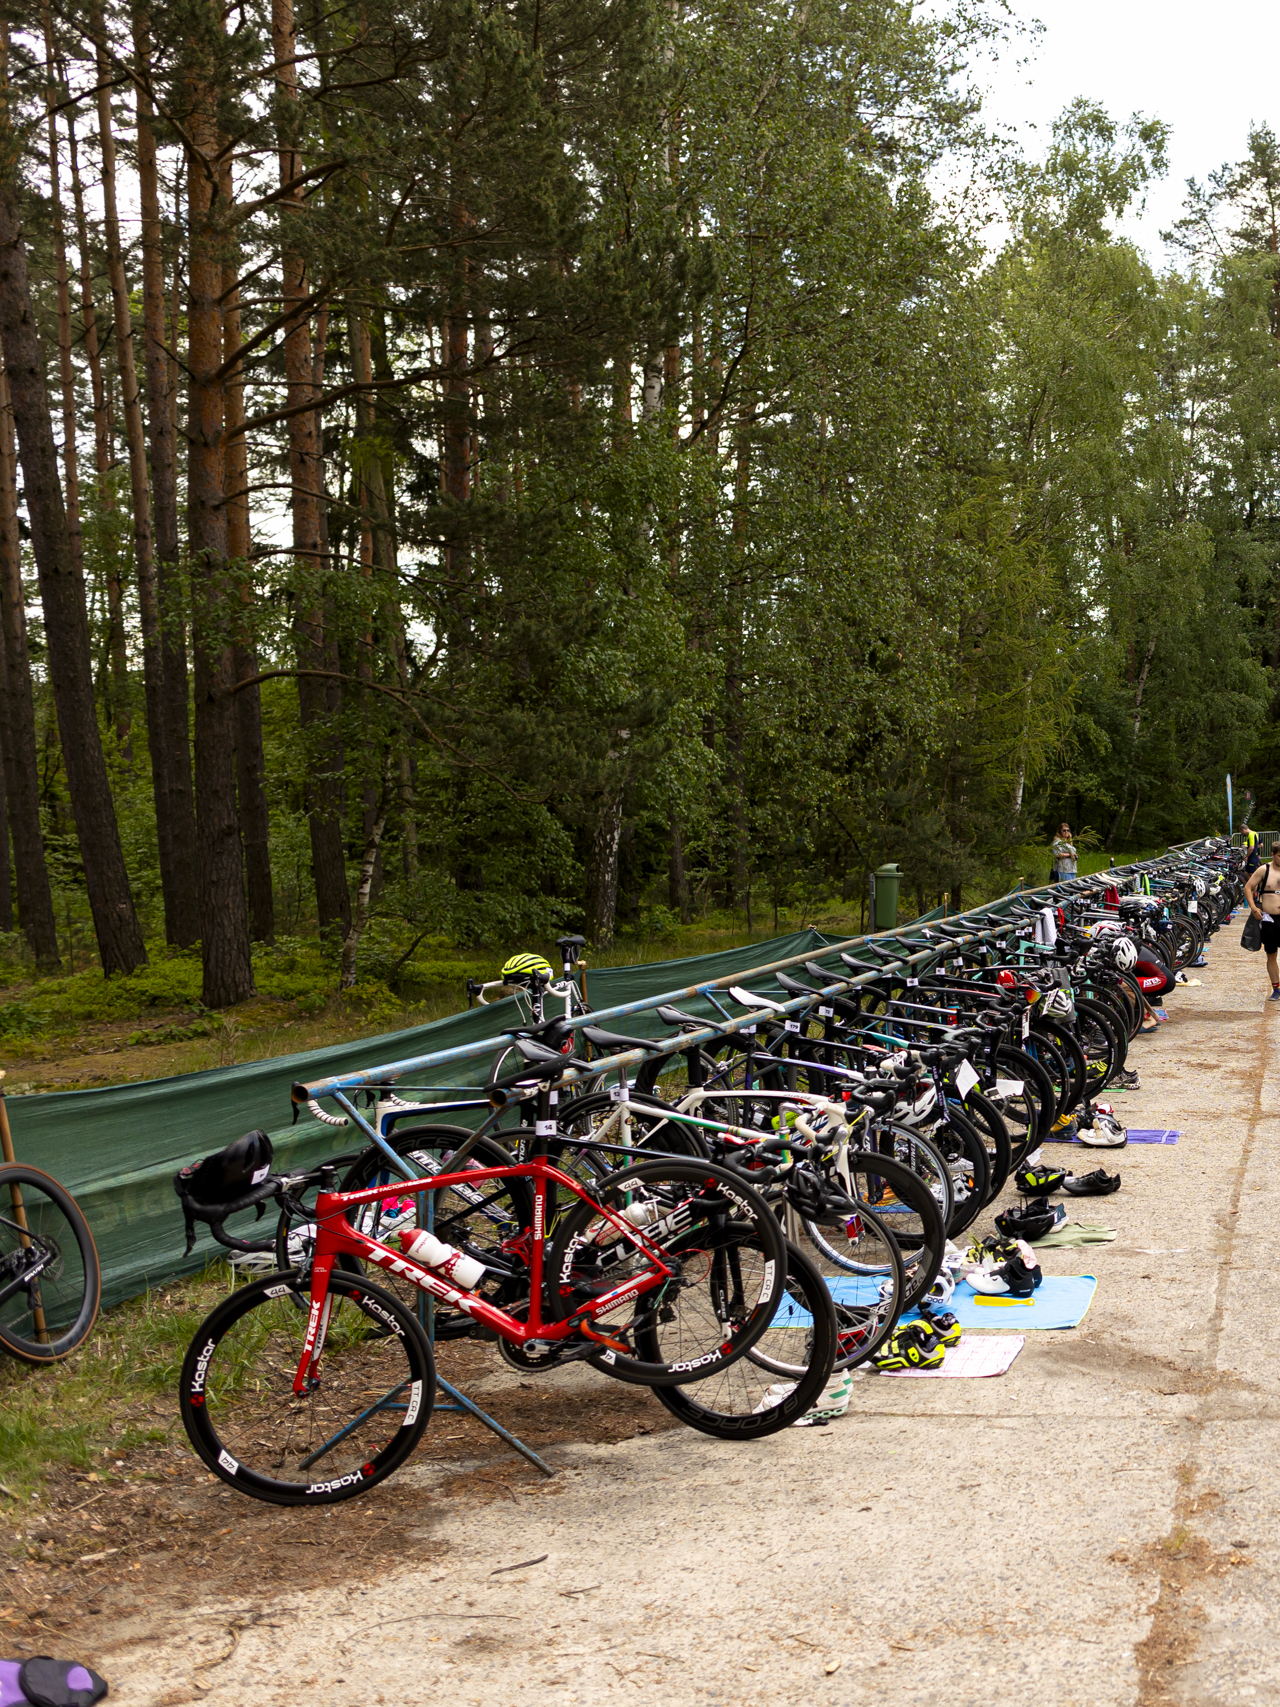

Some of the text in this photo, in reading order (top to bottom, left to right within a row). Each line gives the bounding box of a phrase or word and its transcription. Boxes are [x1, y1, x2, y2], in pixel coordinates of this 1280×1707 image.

[340, 1188, 379, 1202] TREK
[379, 1182, 408, 1193] FACTORY
[623, 1179, 639, 1189] 44
[716, 1181, 759, 1221] Kastar
[533, 1193, 544, 1241] SHIMANO
[559, 1230, 580, 1284] Kastar
[270, 1285, 287, 1296] 44
[365, 1242, 482, 1315] TREK
[361, 1294, 406, 1337] Kastar
[595, 1288, 639, 1316] SHIMANO
[303, 1299, 321, 1354] TREK
[190, 1337, 217, 1393] Kastar
[667, 1349, 722, 1373] Kastar
[221, 1455, 236, 1470] 44
[305, 1469, 364, 1494] Kastar
